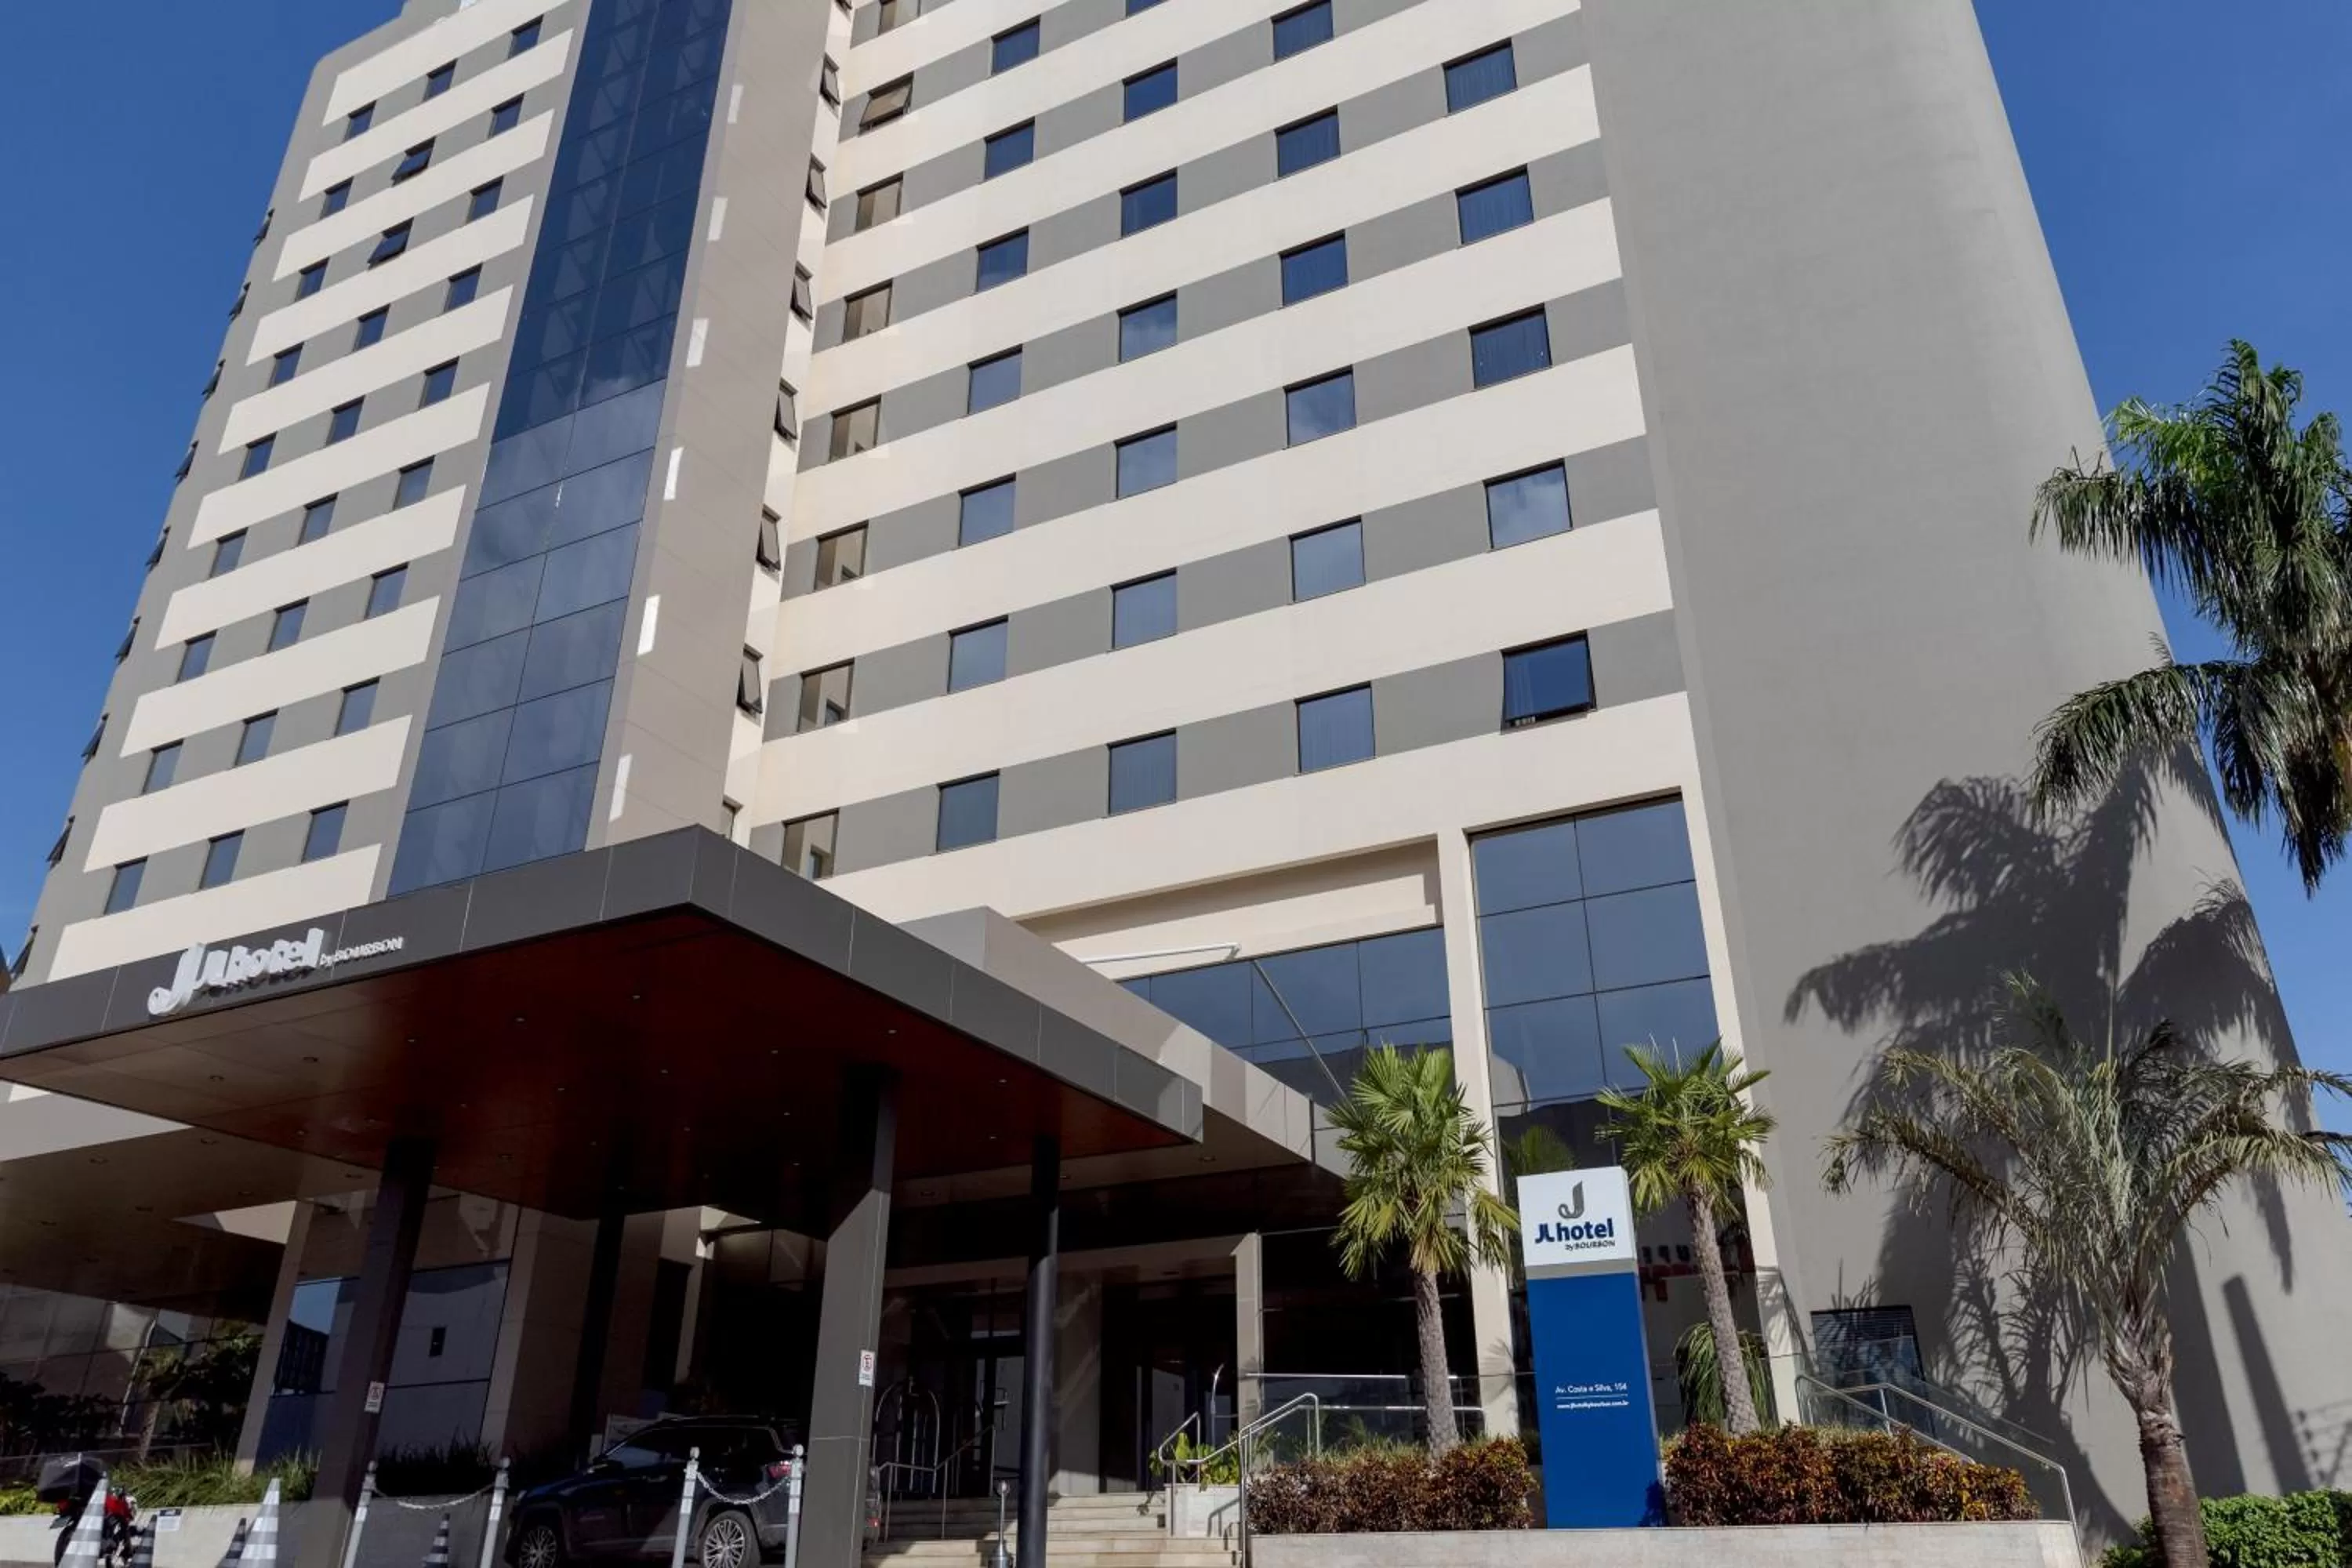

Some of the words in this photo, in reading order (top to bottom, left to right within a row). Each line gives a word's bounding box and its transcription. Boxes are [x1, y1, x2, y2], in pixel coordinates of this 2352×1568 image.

[1555, 1217, 1614, 1242] hotel
[1574, 1240, 1616, 1250] BOURBON
[1568, 1385, 1588, 1393] Costa
